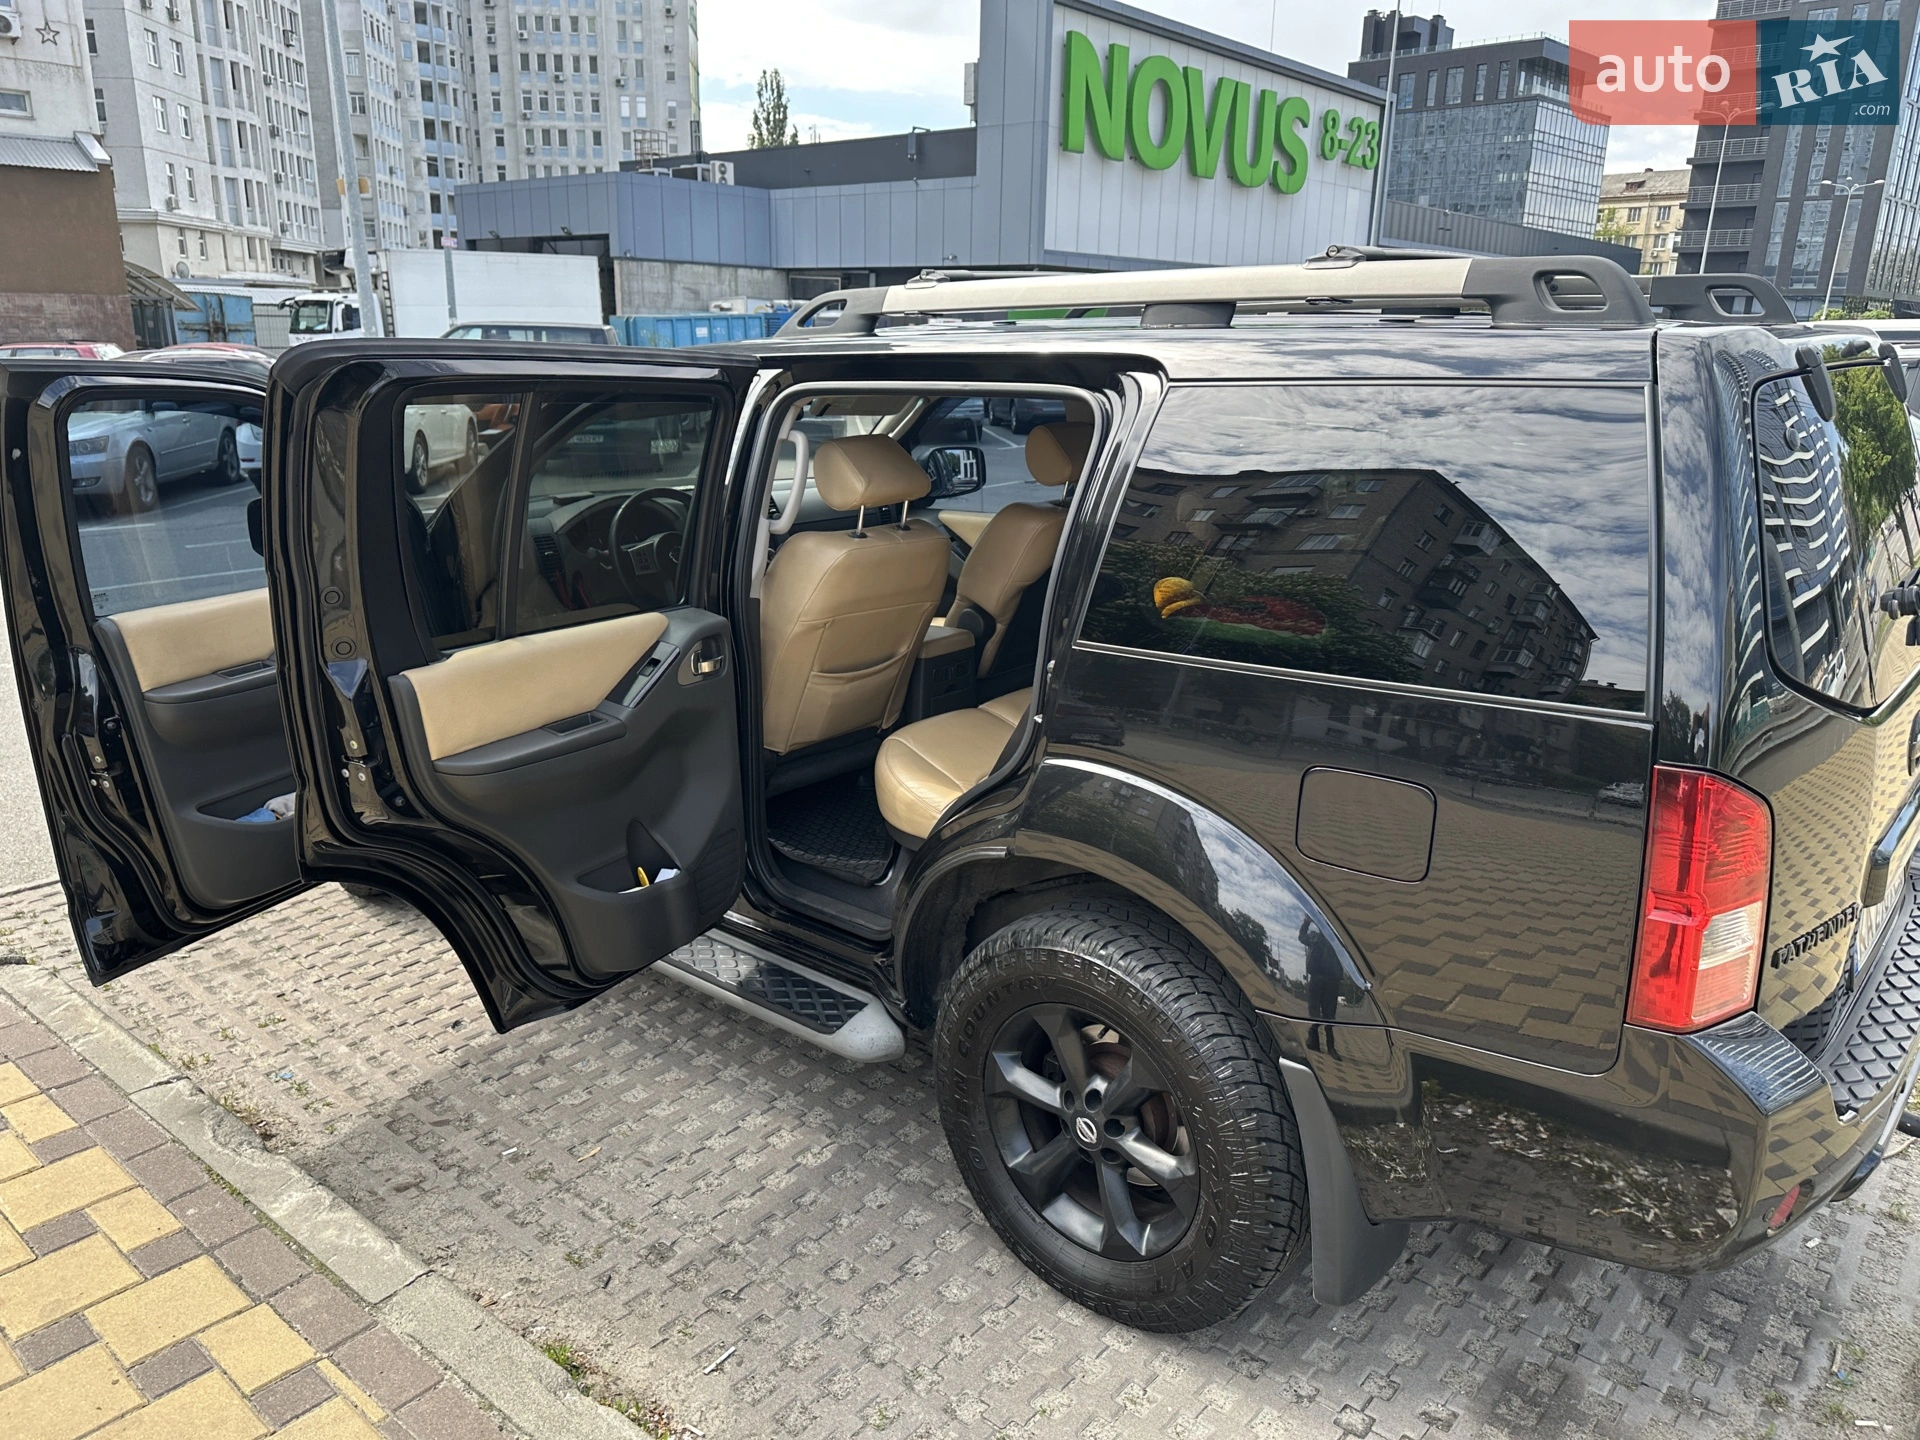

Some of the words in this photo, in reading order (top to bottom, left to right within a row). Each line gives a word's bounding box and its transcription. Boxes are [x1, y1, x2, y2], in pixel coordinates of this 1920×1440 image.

[1062, 30, 1310, 194] NOVUS
[1320, 108, 1379, 170] 8-23
[957, 975, 1057, 1060] COUNTRY
